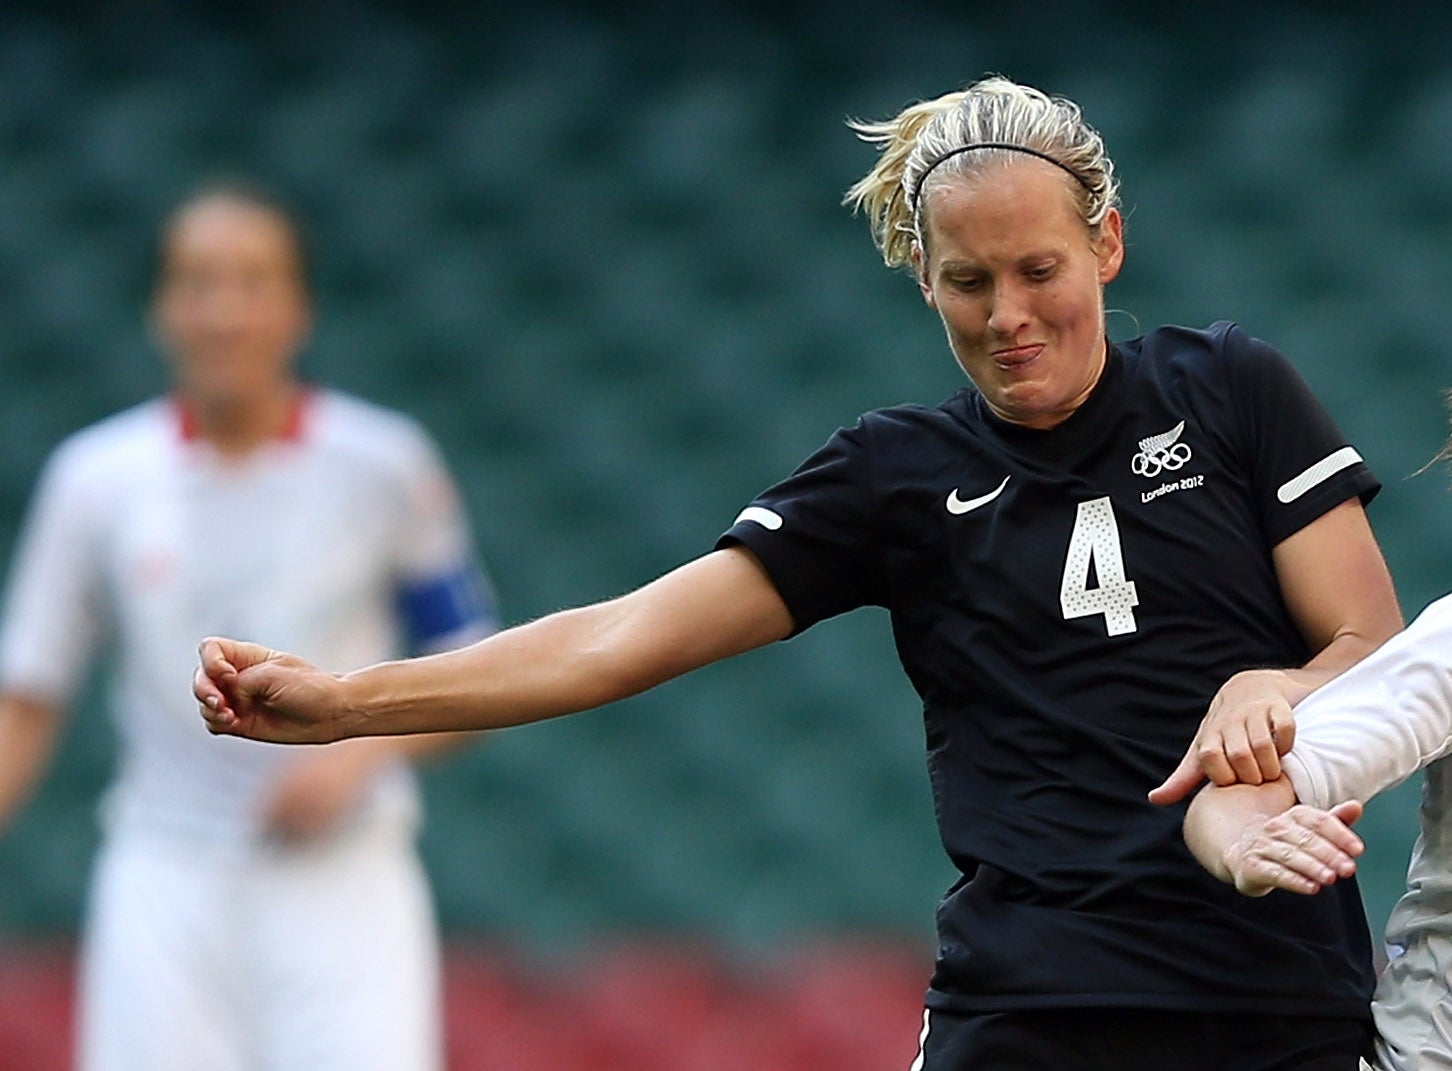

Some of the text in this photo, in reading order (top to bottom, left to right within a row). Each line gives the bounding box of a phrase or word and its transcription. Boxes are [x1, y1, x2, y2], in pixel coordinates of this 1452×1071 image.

[1141, 475, 1204, 503] London 2012
[1060, 496, 1139, 637] 4
